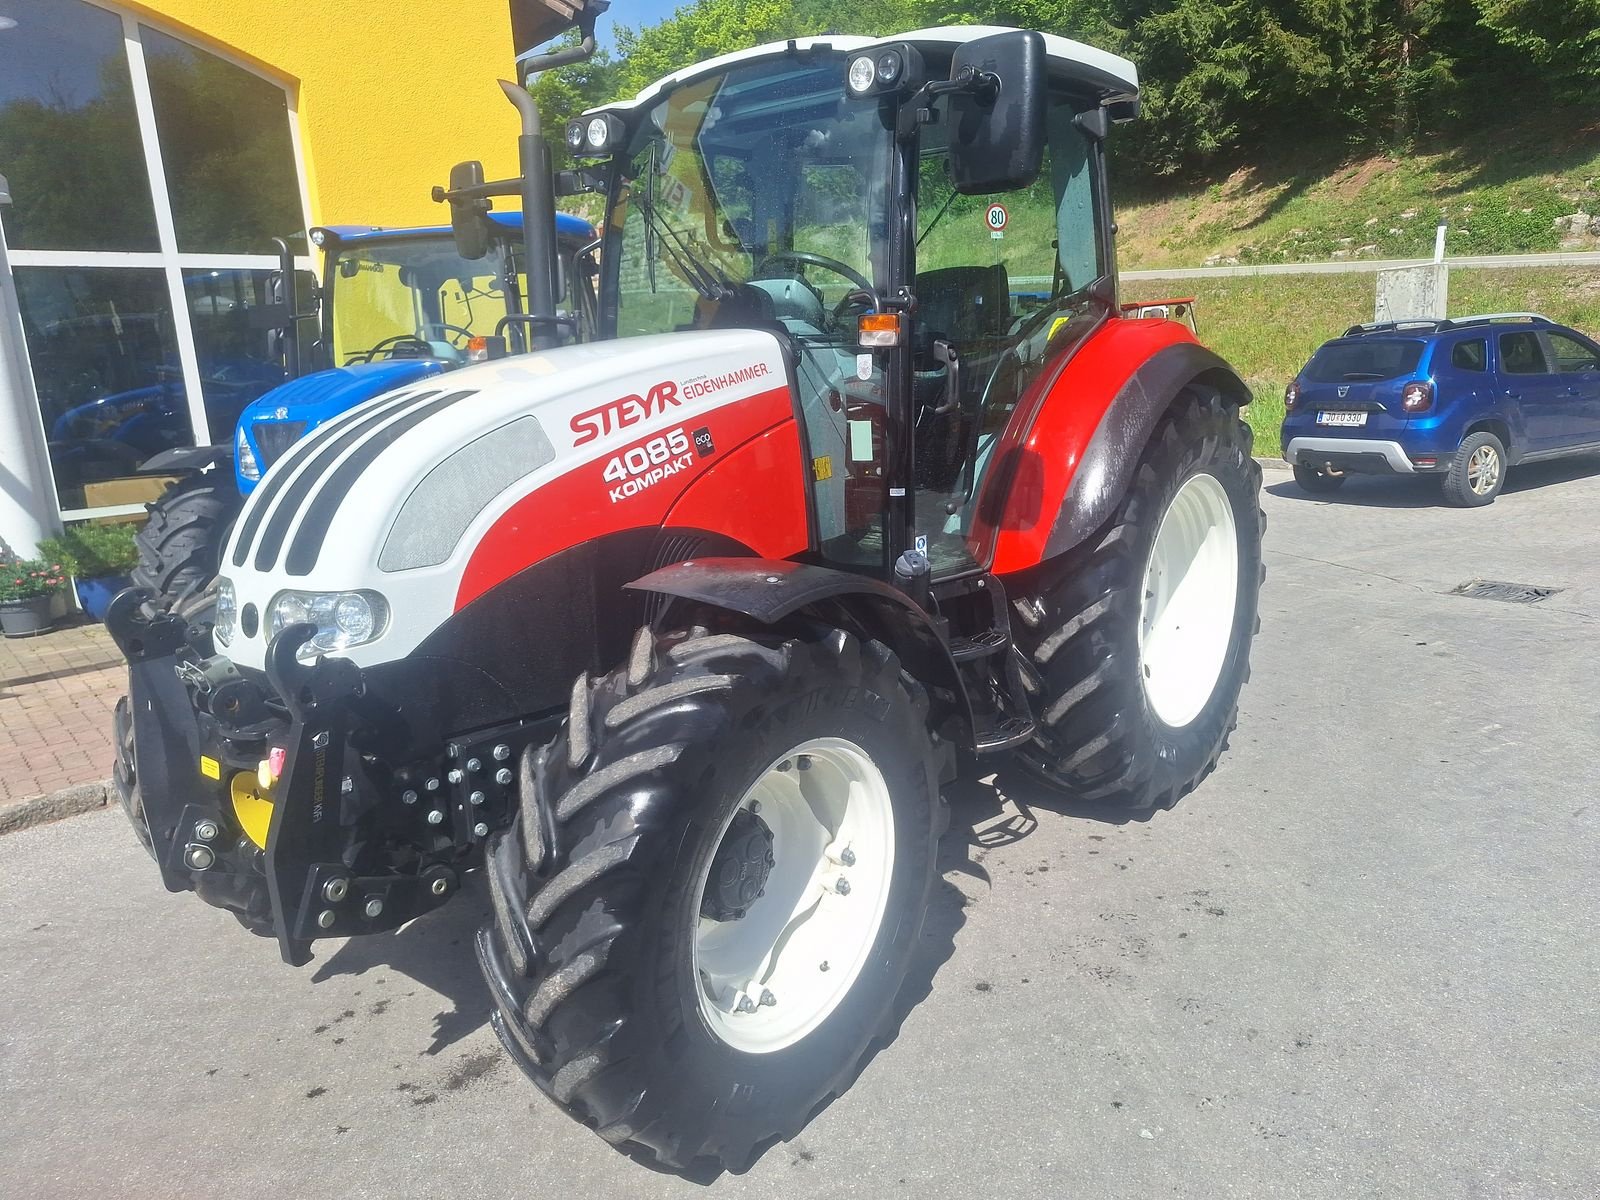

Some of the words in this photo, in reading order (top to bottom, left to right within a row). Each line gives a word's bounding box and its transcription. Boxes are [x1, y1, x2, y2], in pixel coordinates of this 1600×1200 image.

[990, 210, 1004, 225] 80
[683, 362, 769, 400] EIDENHAMMER
[569, 380, 682, 448] STEYR
[602, 427, 689, 484] 4085
[695, 432, 711, 445] eco
[608, 451, 694, 504] KOMPAKT
